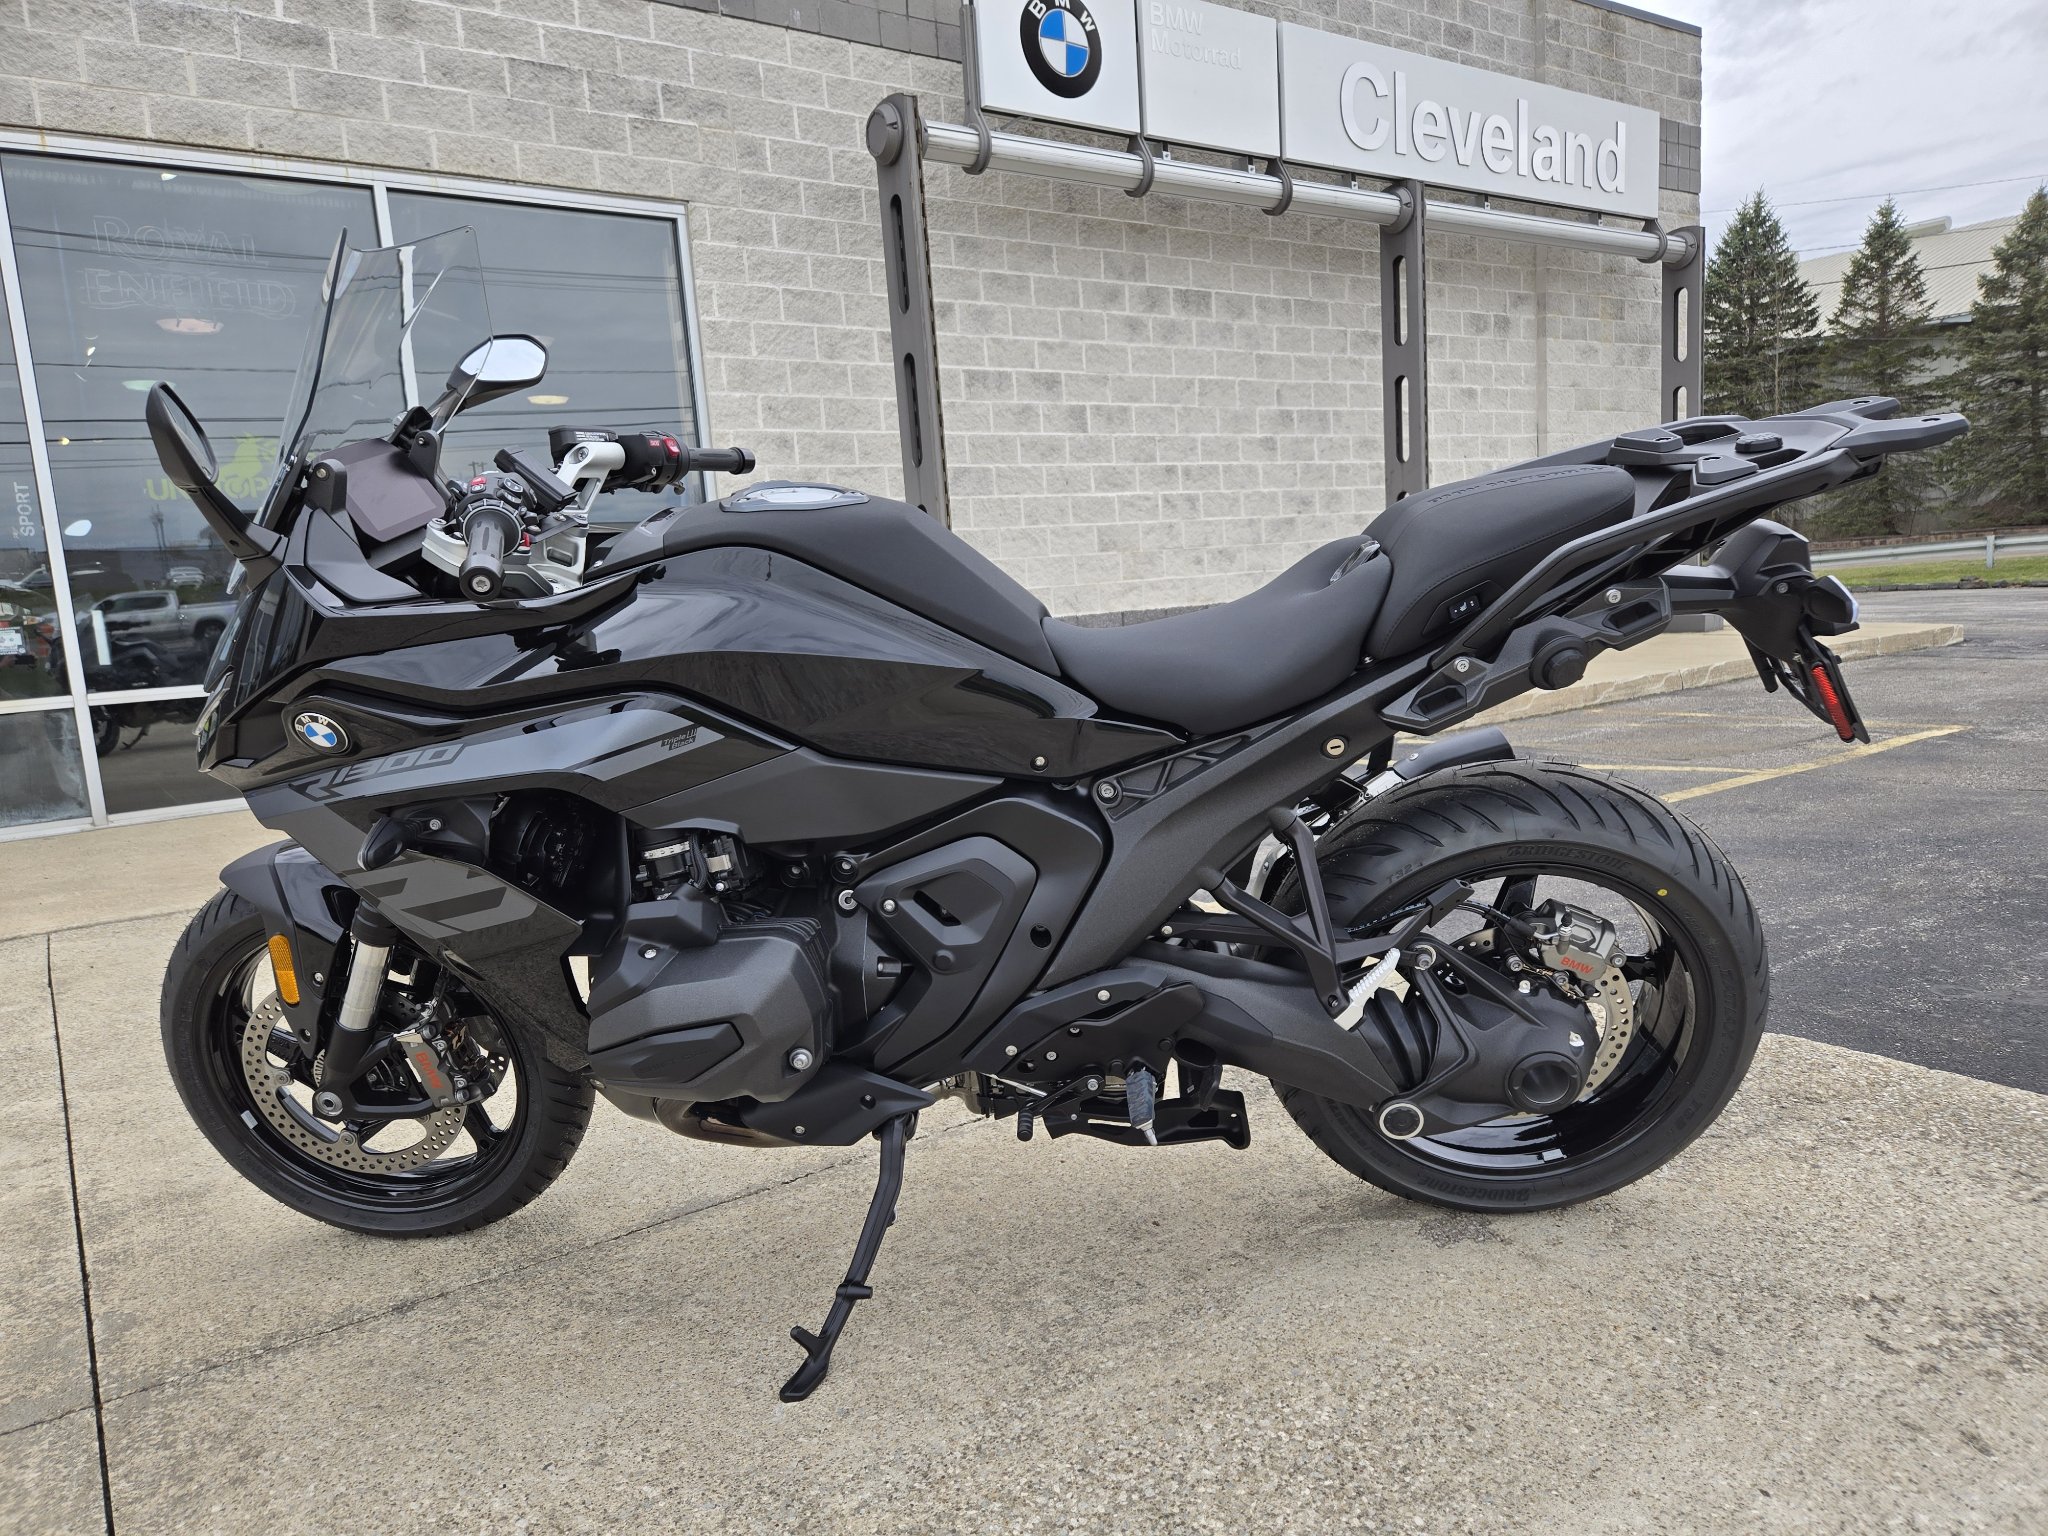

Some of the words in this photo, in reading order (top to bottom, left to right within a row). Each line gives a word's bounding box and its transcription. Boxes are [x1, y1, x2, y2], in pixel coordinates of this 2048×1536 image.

[1028, 0, 1096, 32] BMW
[1149, 1, 1203, 36] BMW
[1150, 28, 1242, 70] Motorrad
[1339, 61, 1626, 194] Cleveland
[91, 214, 270, 266] ROYAL
[13, 481, 36, 537] SPORT
[1506, 844, 1632, 870] BRIDGESTONE
[1560, 956, 1594, 974] BMW
